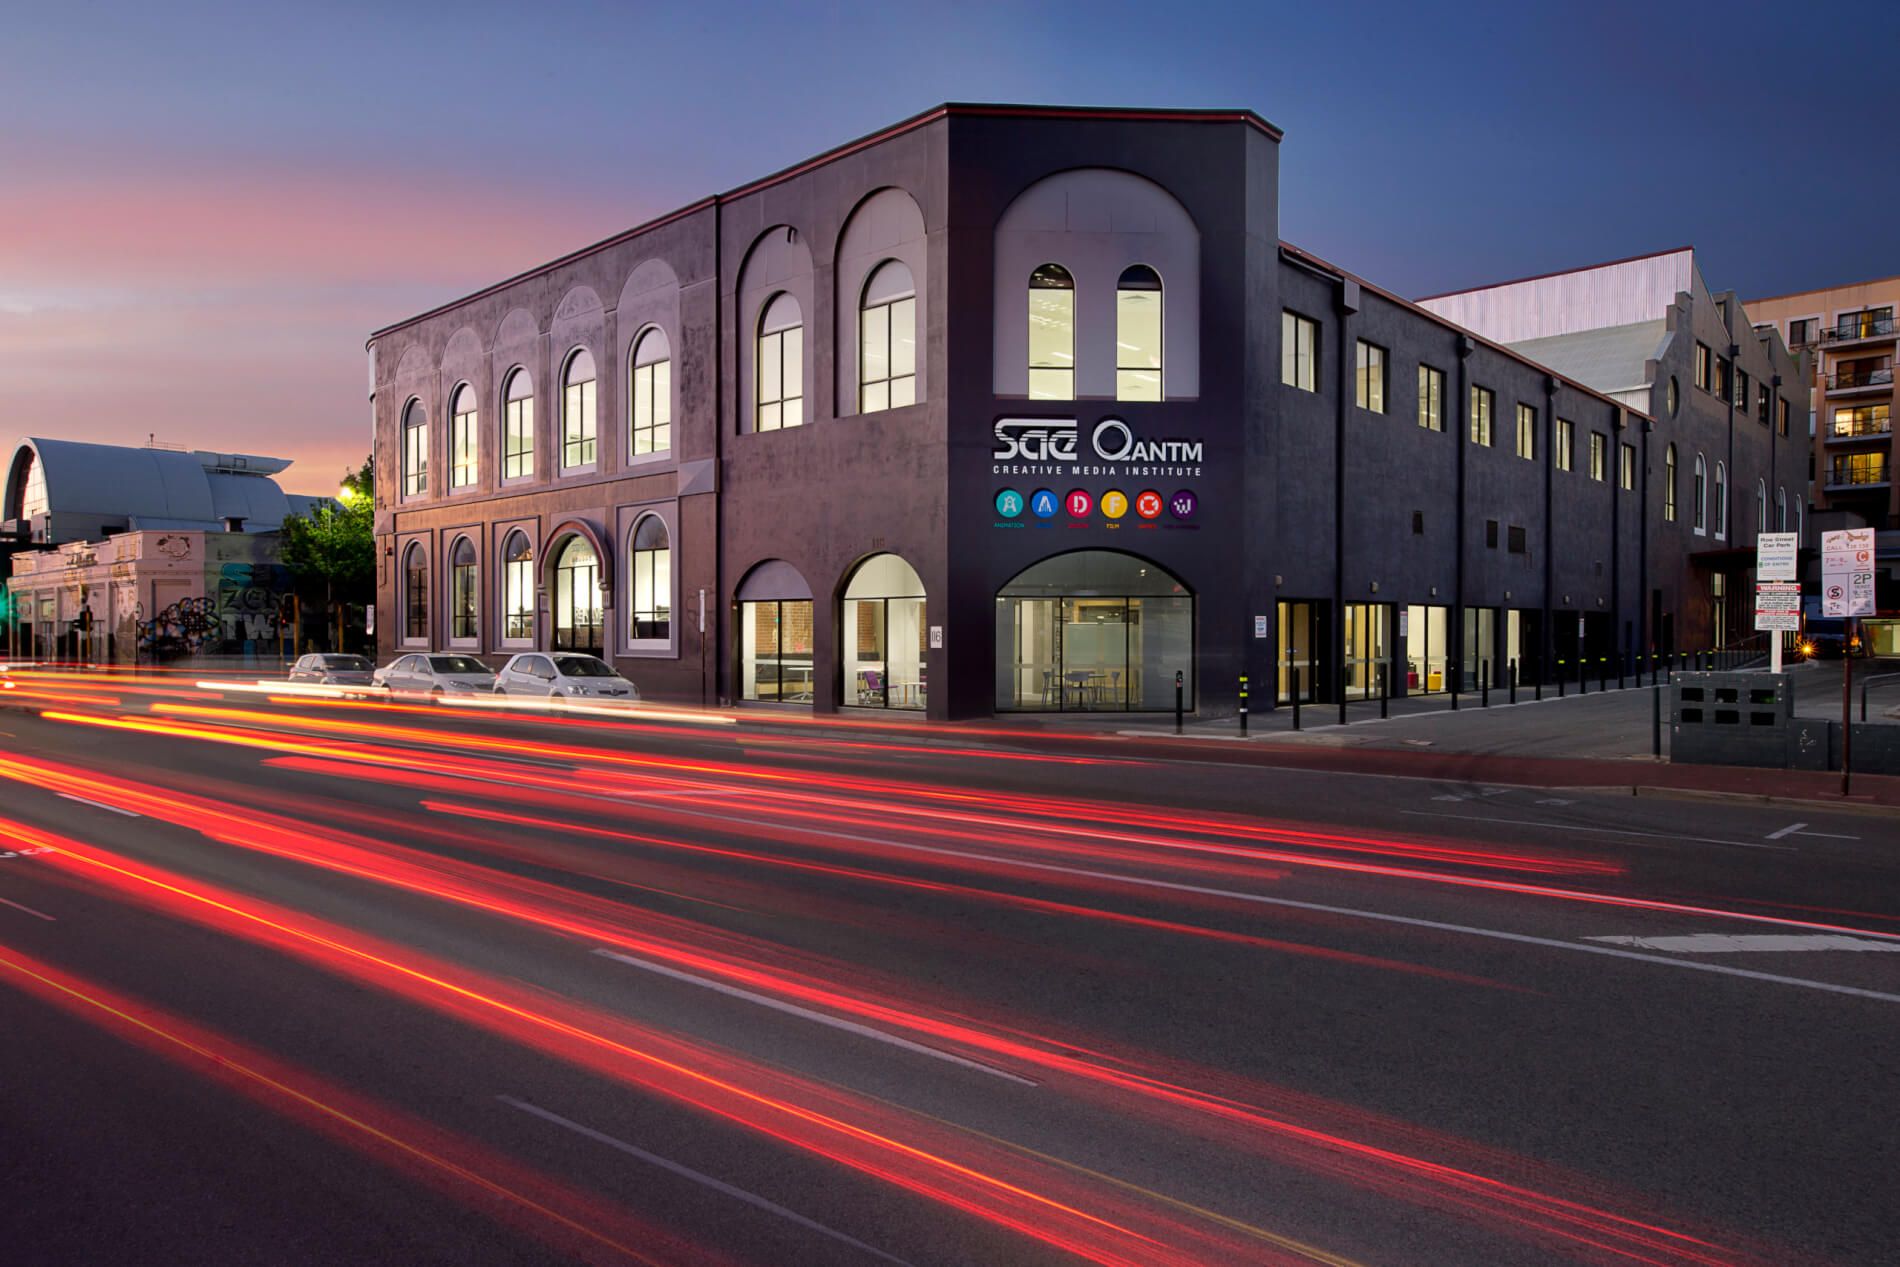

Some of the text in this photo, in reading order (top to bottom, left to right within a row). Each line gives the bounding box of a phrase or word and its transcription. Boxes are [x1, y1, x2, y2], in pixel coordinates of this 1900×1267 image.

[1093, 419, 1203, 463] QANTM
[993, 465, 1202, 477] CREATIVE MEDIA INSTITUTE
[1853, 574, 1872, 585] 2P
